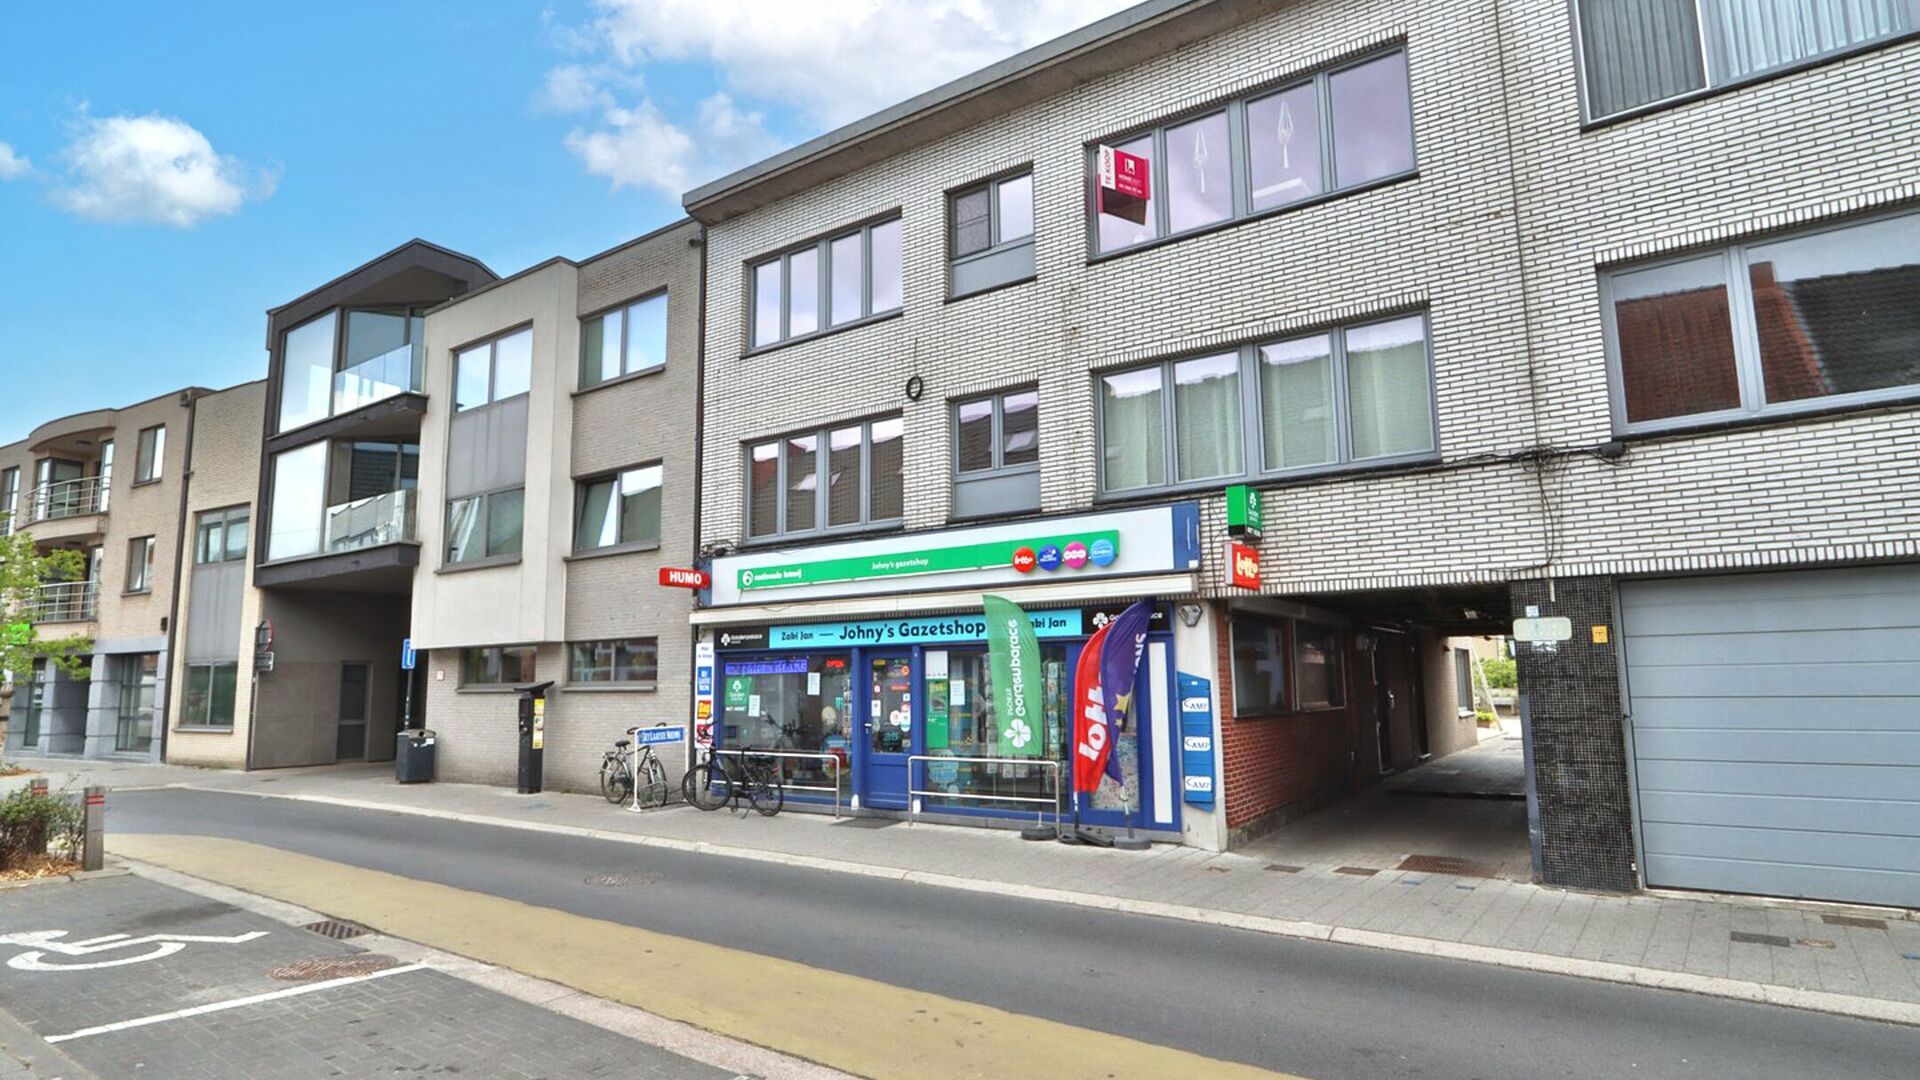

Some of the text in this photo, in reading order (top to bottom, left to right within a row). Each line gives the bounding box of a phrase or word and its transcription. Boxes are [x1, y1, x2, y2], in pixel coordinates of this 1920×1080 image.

[669, 571, 702, 585] HUMO
[800, 631, 814, 641] Jan
[839, 624, 895, 642] Johny's
[898, 619, 986, 638] Gazetshop
[1048, 616, 1067, 629] Jan
[826, 659, 845, 668] OPEN
